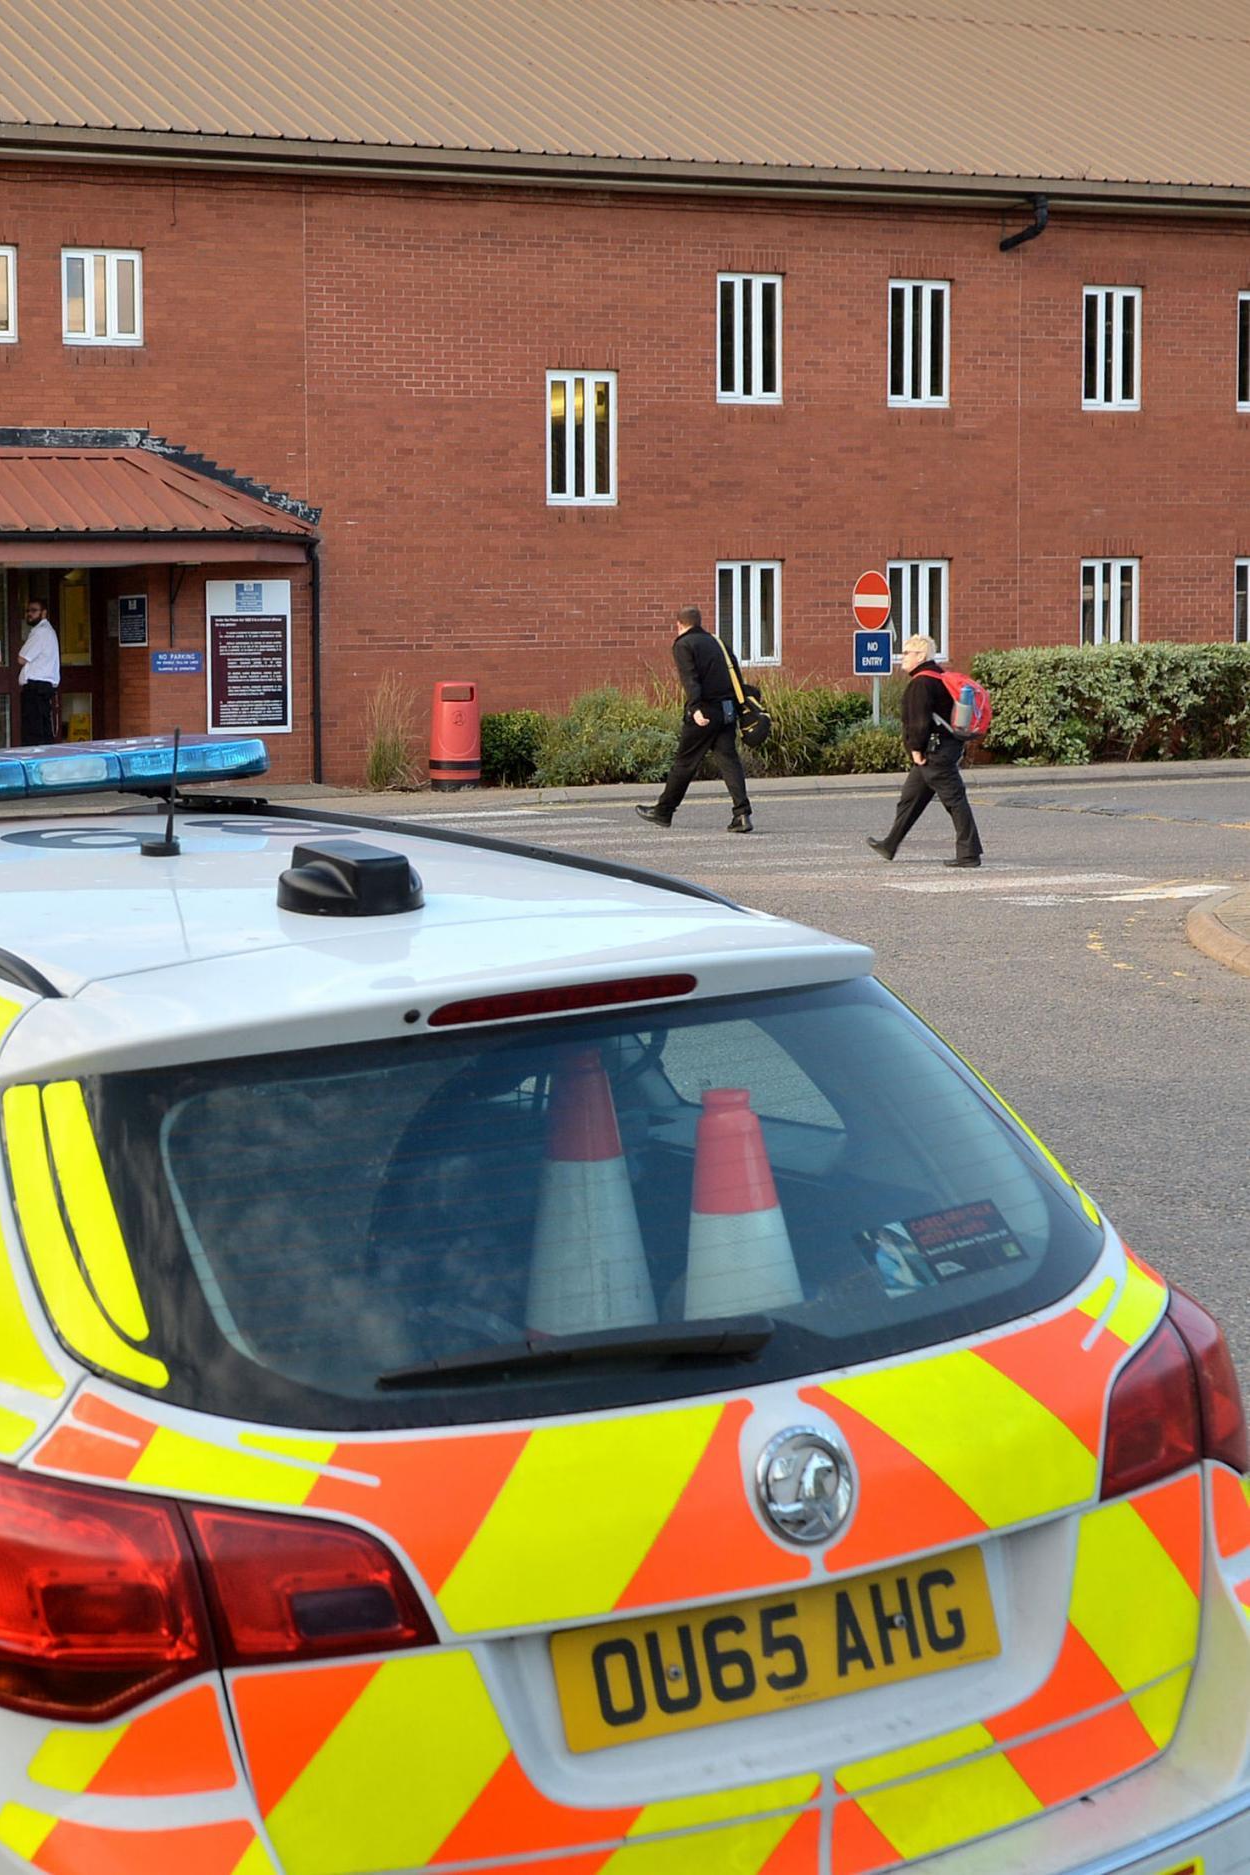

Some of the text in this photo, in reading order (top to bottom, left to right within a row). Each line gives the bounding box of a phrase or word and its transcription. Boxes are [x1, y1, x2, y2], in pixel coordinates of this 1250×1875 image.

[867, 641, 878, 651] NO
[861, 656, 883, 666] ENTRY
[591, 1568, 966, 1727] OU65 AHG
